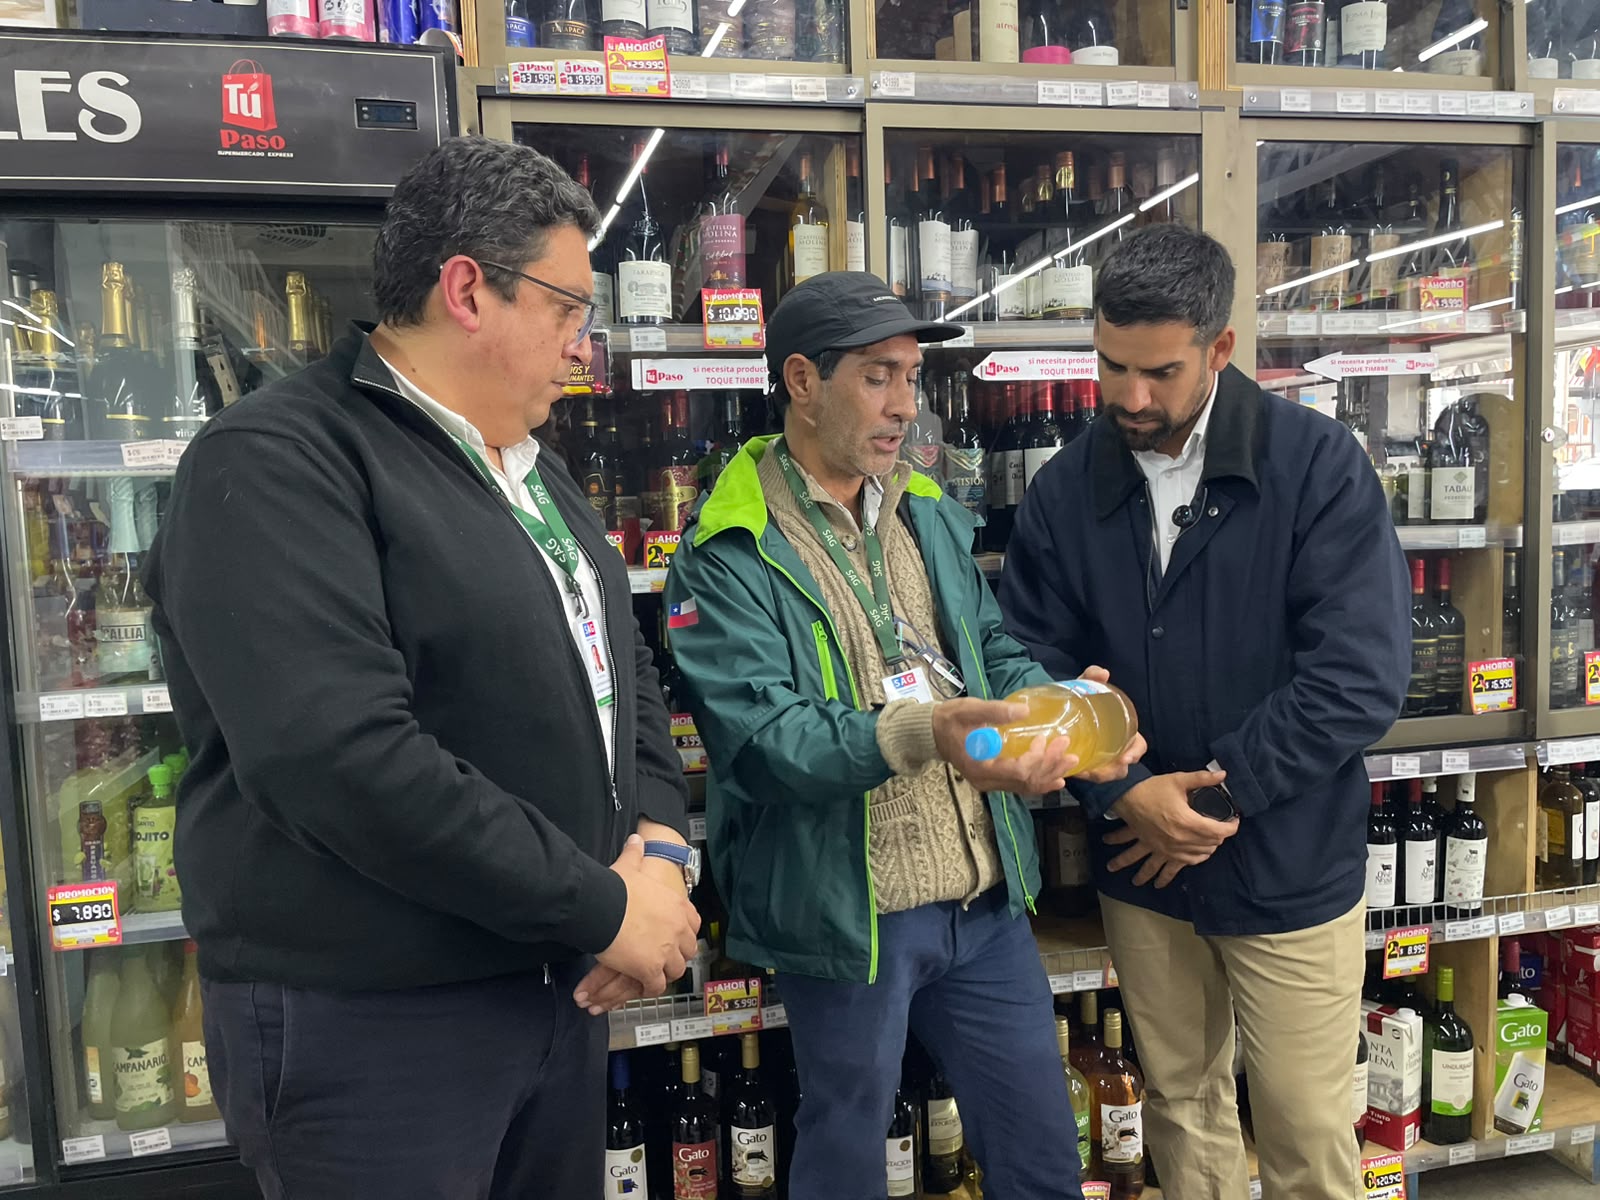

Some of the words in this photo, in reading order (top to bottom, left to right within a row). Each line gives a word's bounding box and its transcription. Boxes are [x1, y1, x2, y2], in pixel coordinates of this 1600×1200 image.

[552, 25, 585, 35] TAAPACA
[617, 39, 664, 52] AHORRO
[526, 64, 553, 72] Paso
[572, 64, 600, 72] Paso
[224, 82, 262, 119] Tú
[220, 129, 286, 150] Paso
[996, 365, 1020, 373] Paso
[658, 372, 684, 382] Paso
[778, 453, 790, 472] SAG
[531, 484, 550, 505] SAG
[799, 491, 814, 510] SAG
[822, 528, 838, 548] SAG
[546, 538, 567, 563] SAG
[561, 537, 578, 560] SAG
[874, 560, 883, 577] SAG
[845, 569, 862, 587] SAG
[869, 608, 884, 628] SAG
[1480, 660, 1513, 672] AHORRO
[894, 674, 914, 688] SAG
[58, 886, 114, 900] PROMOCION
[53, 908, 60, 921] $
[1396, 928, 1429, 938] AHORRO
[717, 980, 759, 992] AHORO
[734, 998, 757, 1009] 5.990
[1500, 1022, 1542, 1043] Gato
[1513, 1072, 1538, 1092] Gato
[1109, 1110, 1137, 1123] Gato
[737, 1131, 767, 1145] Gato
[679, 1148, 709, 1162] Gato
[1370, 1156, 1402, 1168] AHORRO
[610, 1165, 638, 1178] Gato
